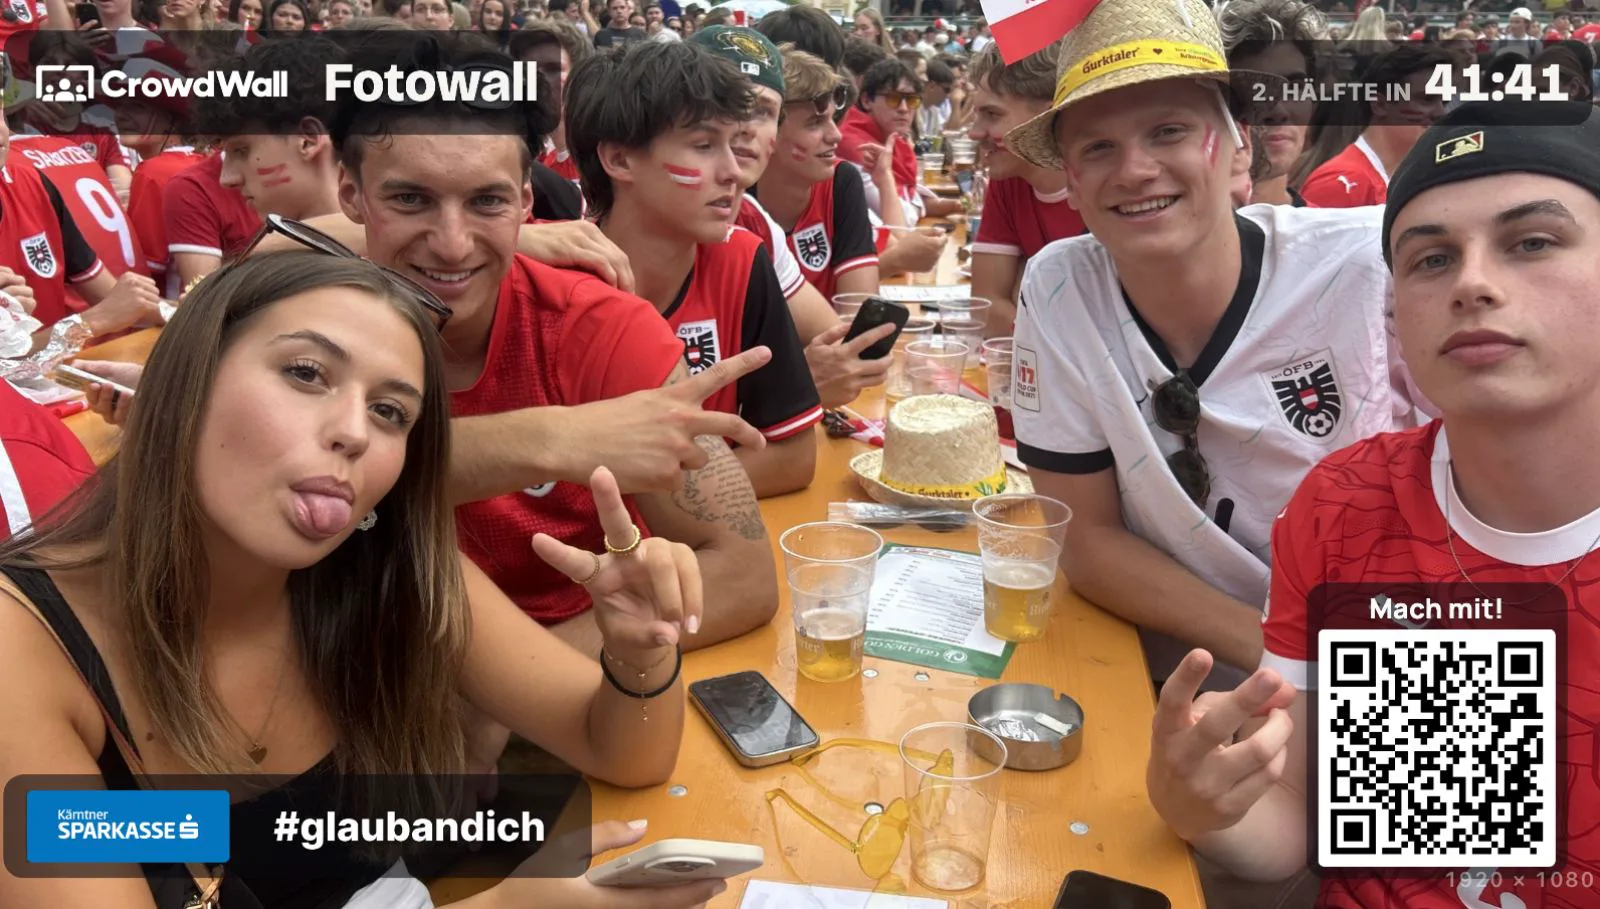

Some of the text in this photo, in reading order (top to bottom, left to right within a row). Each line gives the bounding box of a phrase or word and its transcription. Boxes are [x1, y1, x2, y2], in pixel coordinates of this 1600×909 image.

[1082, 46, 1140, 74] Gurktaler
[75, 177, 135, 268] 9
[1283, 361, 1314, 377] ÖFB
